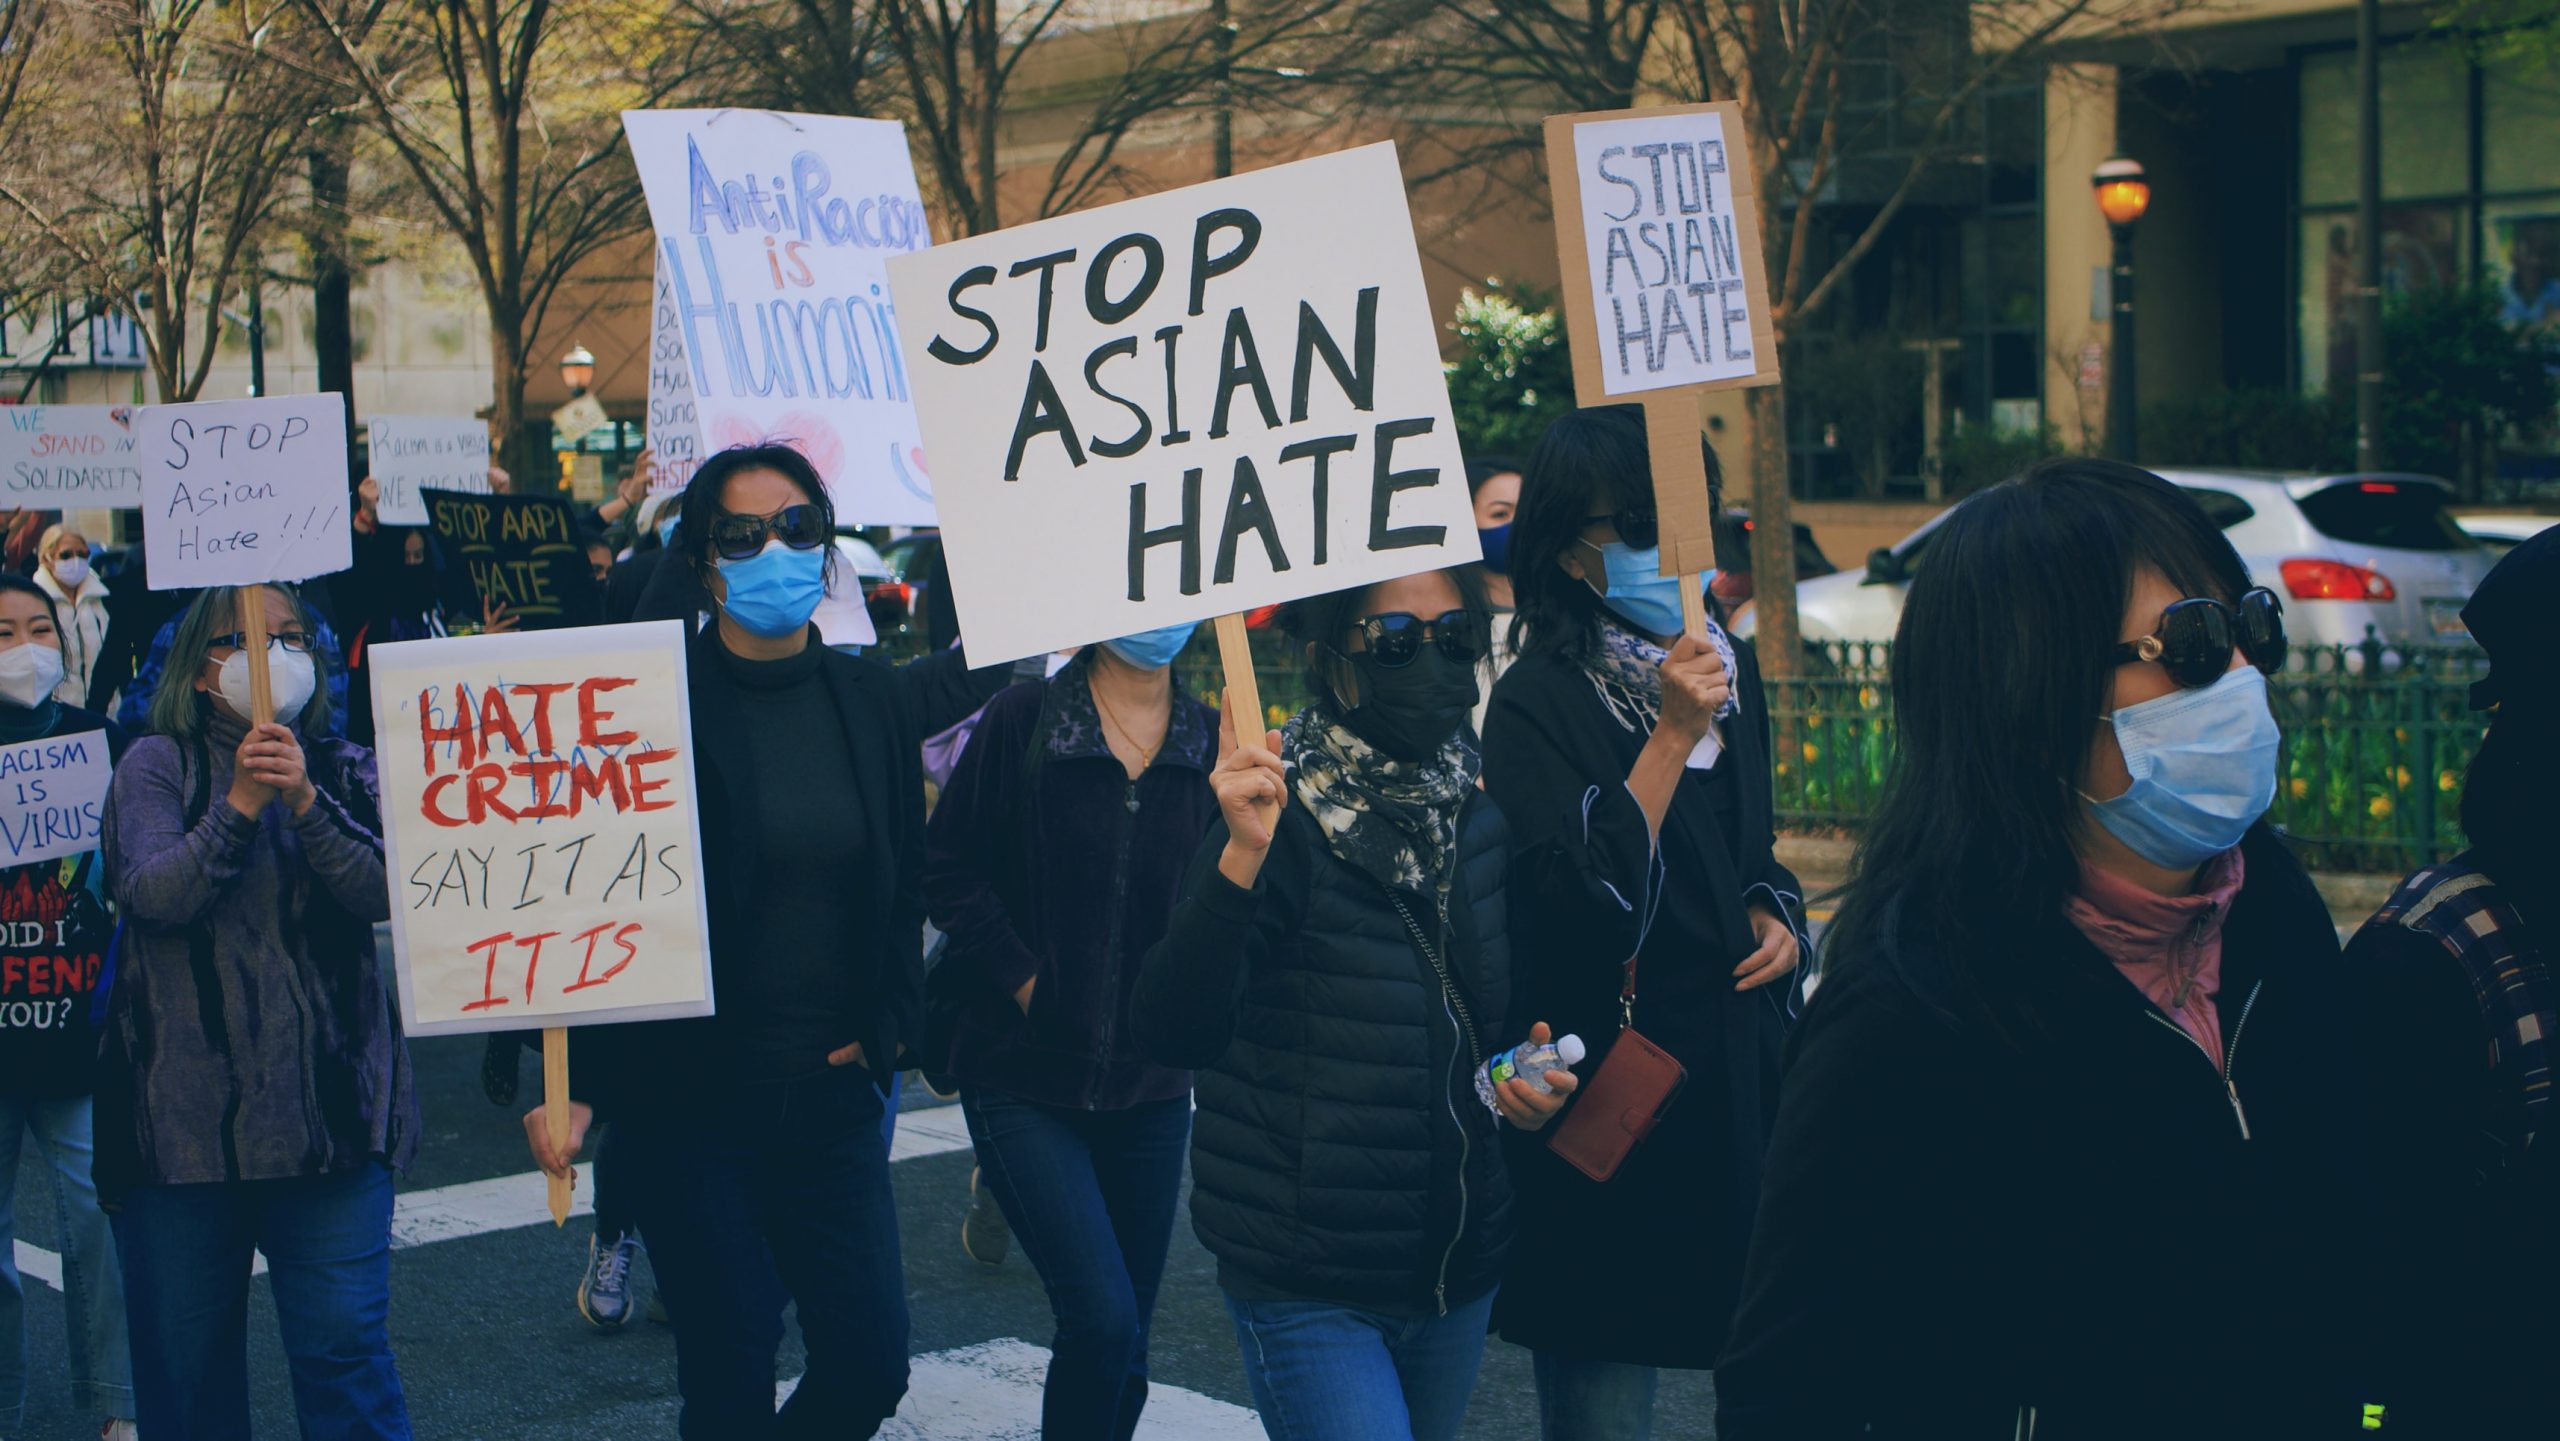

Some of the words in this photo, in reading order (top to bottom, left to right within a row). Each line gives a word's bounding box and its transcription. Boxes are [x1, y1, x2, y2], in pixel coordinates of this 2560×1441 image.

[1599, 140, 1726, 221] STOP
[763, 235, 815, 289] is
[927, 207, 1262, 365] STOP
[1605, 215, 1738, 295] ASIAN
[1611, 279, 1751, 375] HATE
[10, 407, 46, 432] WE
[1003, 286, 1380, 481] ASIAN
[31, 433, 105, 458] STAND
[115, 437, 136, 453] IN
[166, 416, 309, 470] STOP
[168, 481, 277, 518] Asian
[435, 500, 491, 542] STOP
[502, 503, 569, 542] AAPI
[1127, 416, 1447, 601] HATE
[469, 559, 560, 604] HATE
[419, 677, 639, 776] HATE
[17, 779, 47, 805] IS
[421, 747, 680, 827] CRIME
[410, 846, 496, 909] SAY
[511, 833, 596, 910] IT
[603, 832, 682, 903] AS
[55, 920, 66, 947] I
[461, 930, 562, 1011] IT
[563, 921, 643, 993] IS
